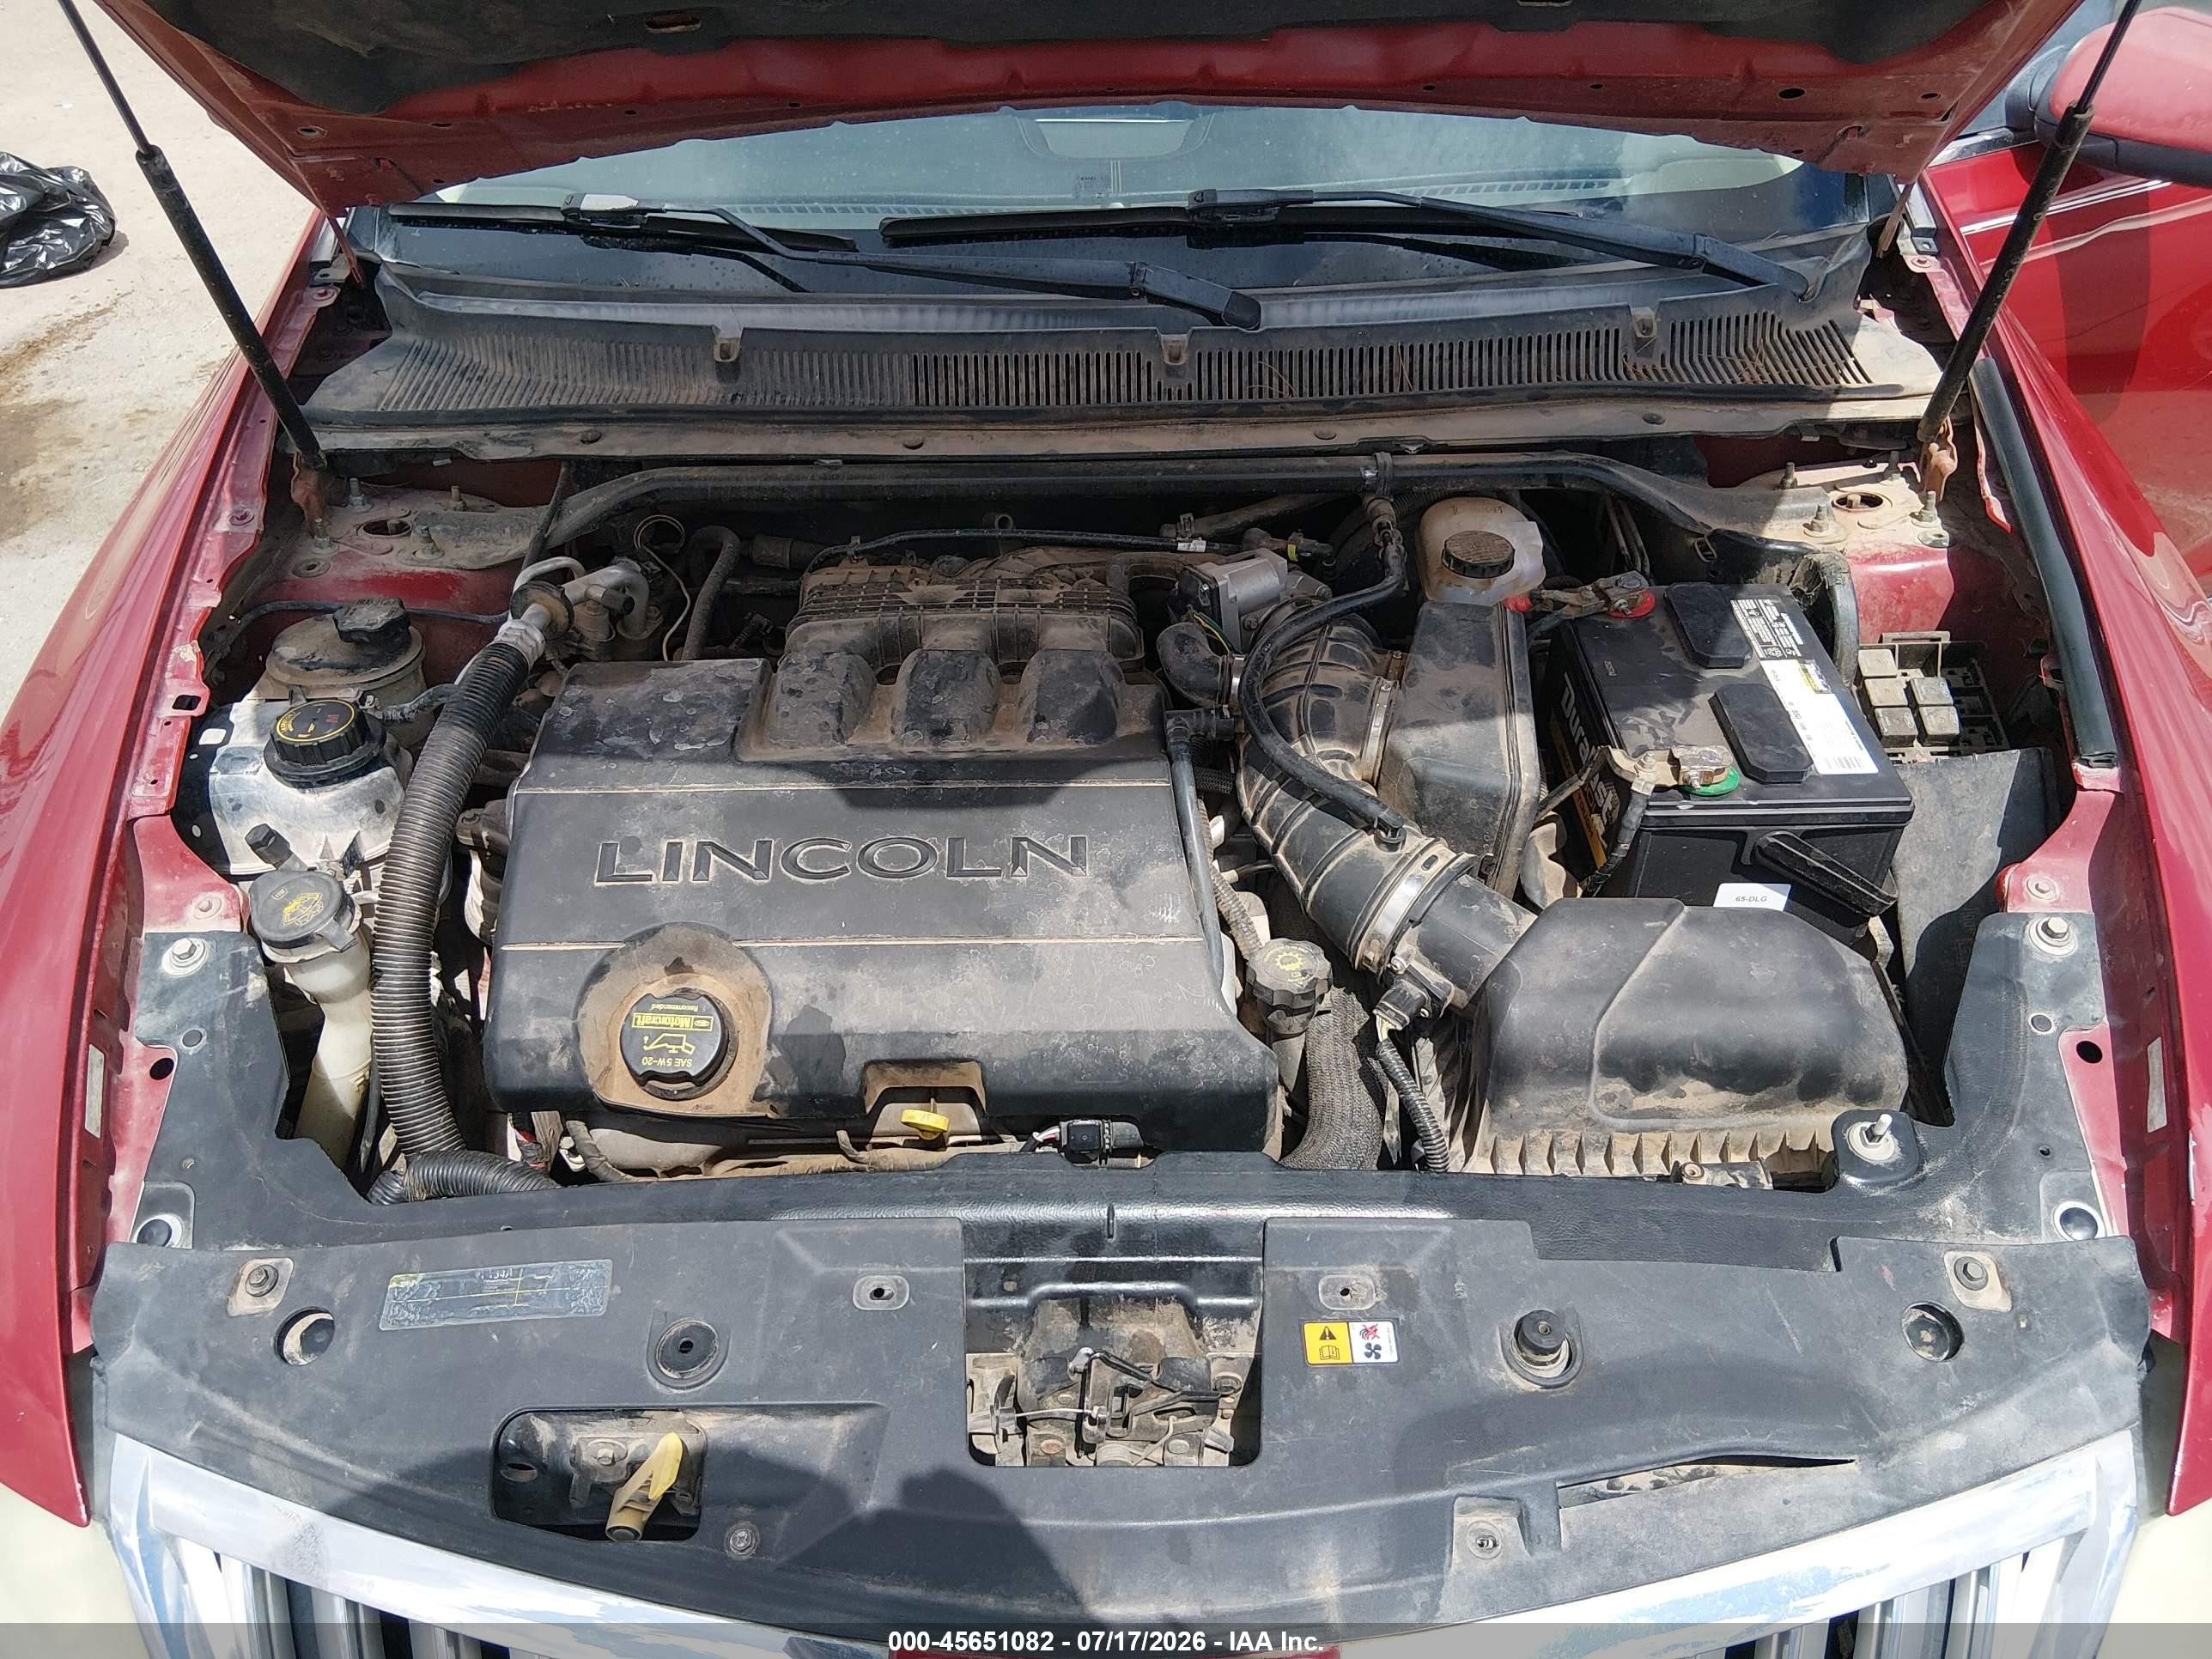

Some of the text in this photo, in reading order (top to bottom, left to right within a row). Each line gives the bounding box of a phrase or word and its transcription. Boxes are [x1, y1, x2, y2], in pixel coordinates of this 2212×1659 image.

[594, 836, 1088, 884] LINCOLN
[651, 1003, 699, 1012] Recommended
[635, 1015, 691, 1028] Motorcraft
[641, 1056, 693, 1067] SAE 5W-20
